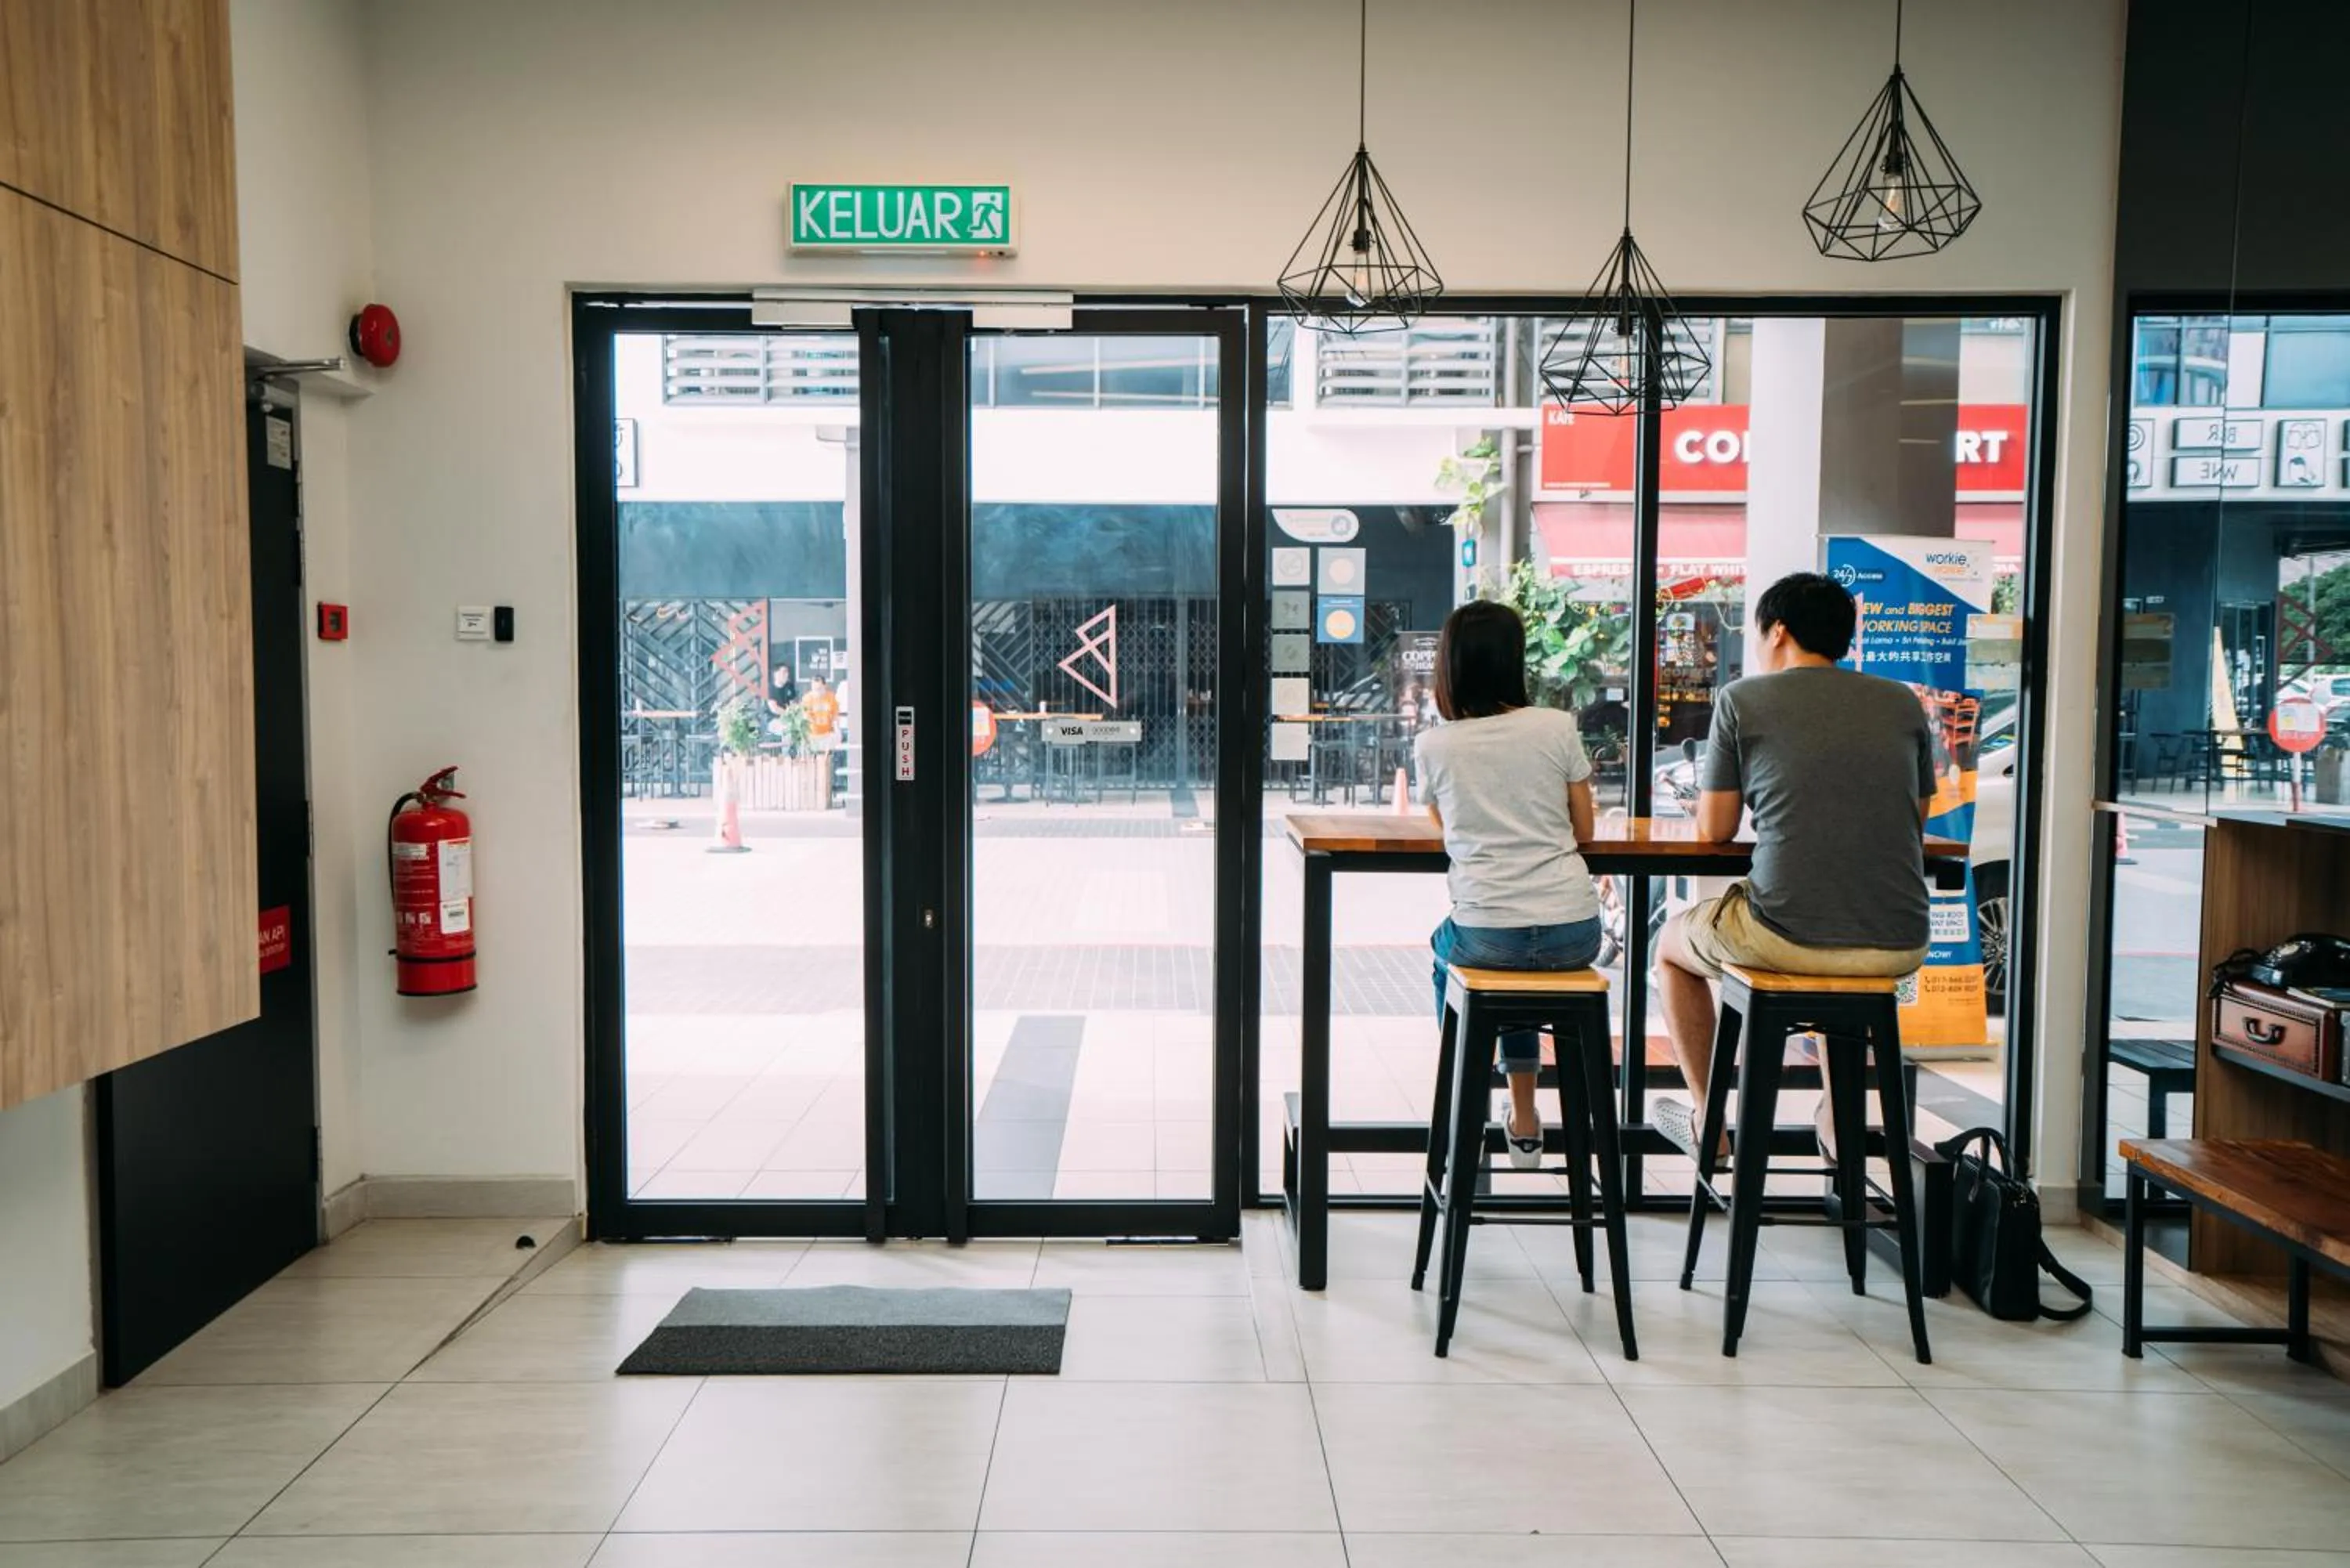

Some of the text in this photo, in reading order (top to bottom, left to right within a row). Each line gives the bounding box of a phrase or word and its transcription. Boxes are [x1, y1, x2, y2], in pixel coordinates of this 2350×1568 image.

[799, 190, 963, 239] KELUAR
[1573, 563, 1632, 575] ESPRES
[1907, 602, 1954, 617] BIGGEST
[1920, 620, 1953, 634] SPACE
[1061, 726, 1084, 735] VISA
[902, 728, 910, 776] PUSH
